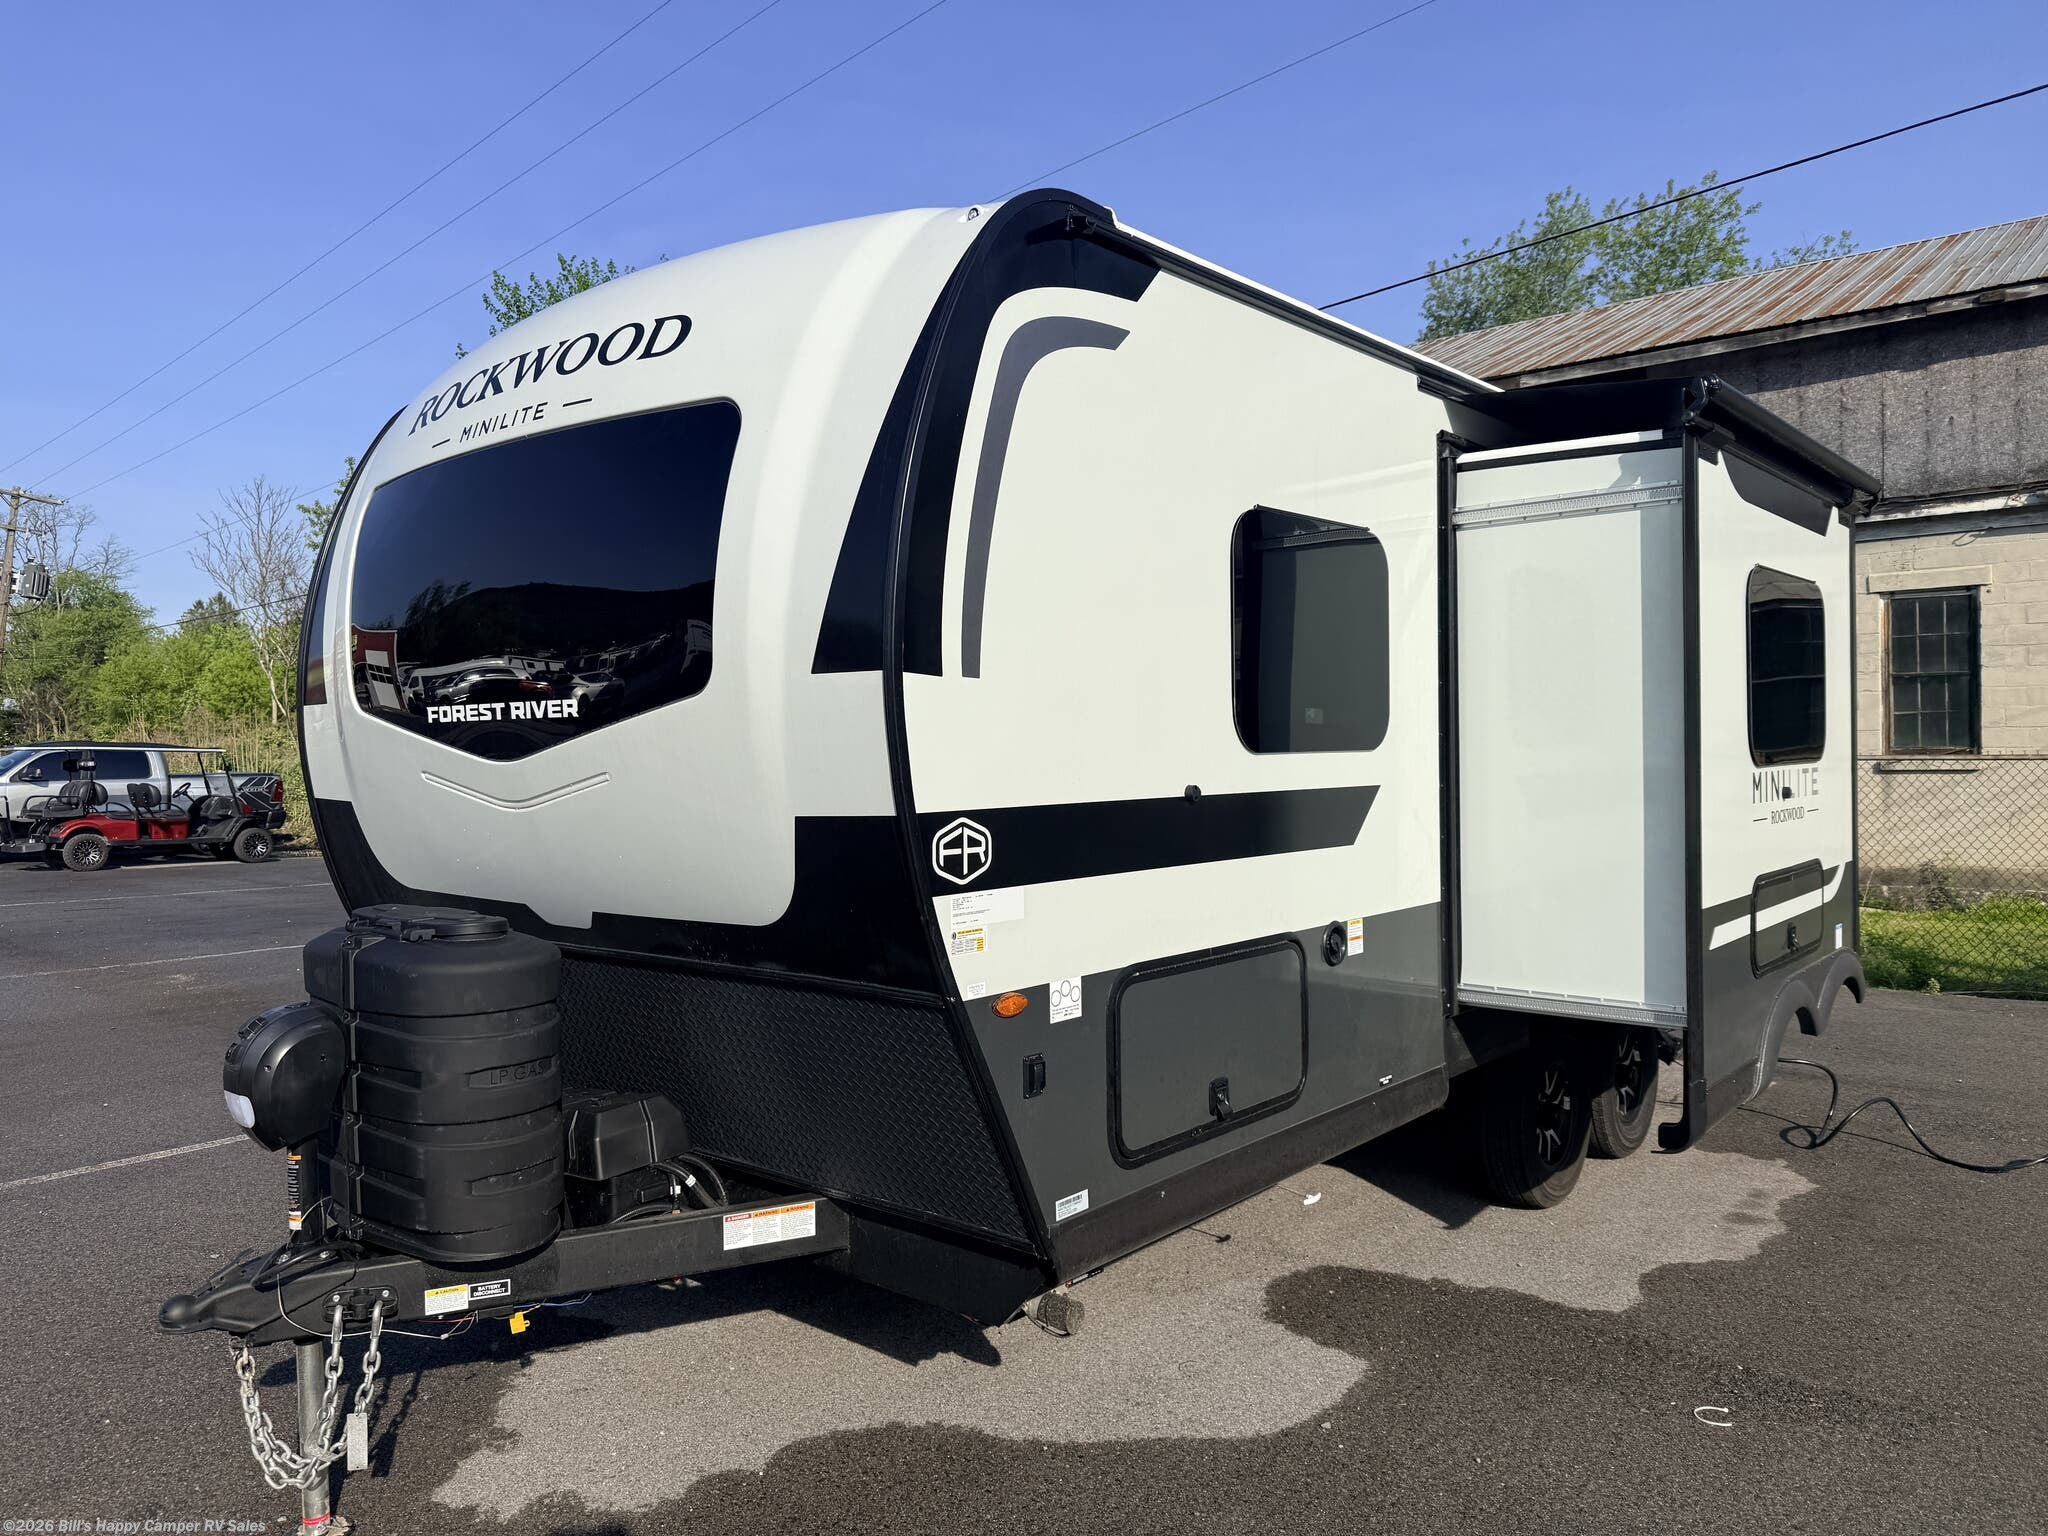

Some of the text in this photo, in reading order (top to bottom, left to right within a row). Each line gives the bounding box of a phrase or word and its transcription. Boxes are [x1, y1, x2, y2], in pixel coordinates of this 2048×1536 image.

[408, 314, 693, 437] ROCKWOOD
[459, 402, 549, 443] MINILITE
[427, 699, 579, 723] FOREST RIVER
[1771, 806, 1805, 825] ROCKWOOD
[490, 1060, 545, 1086] LP GAS
[473, 1288, 506, 1297] DISCONNECT
